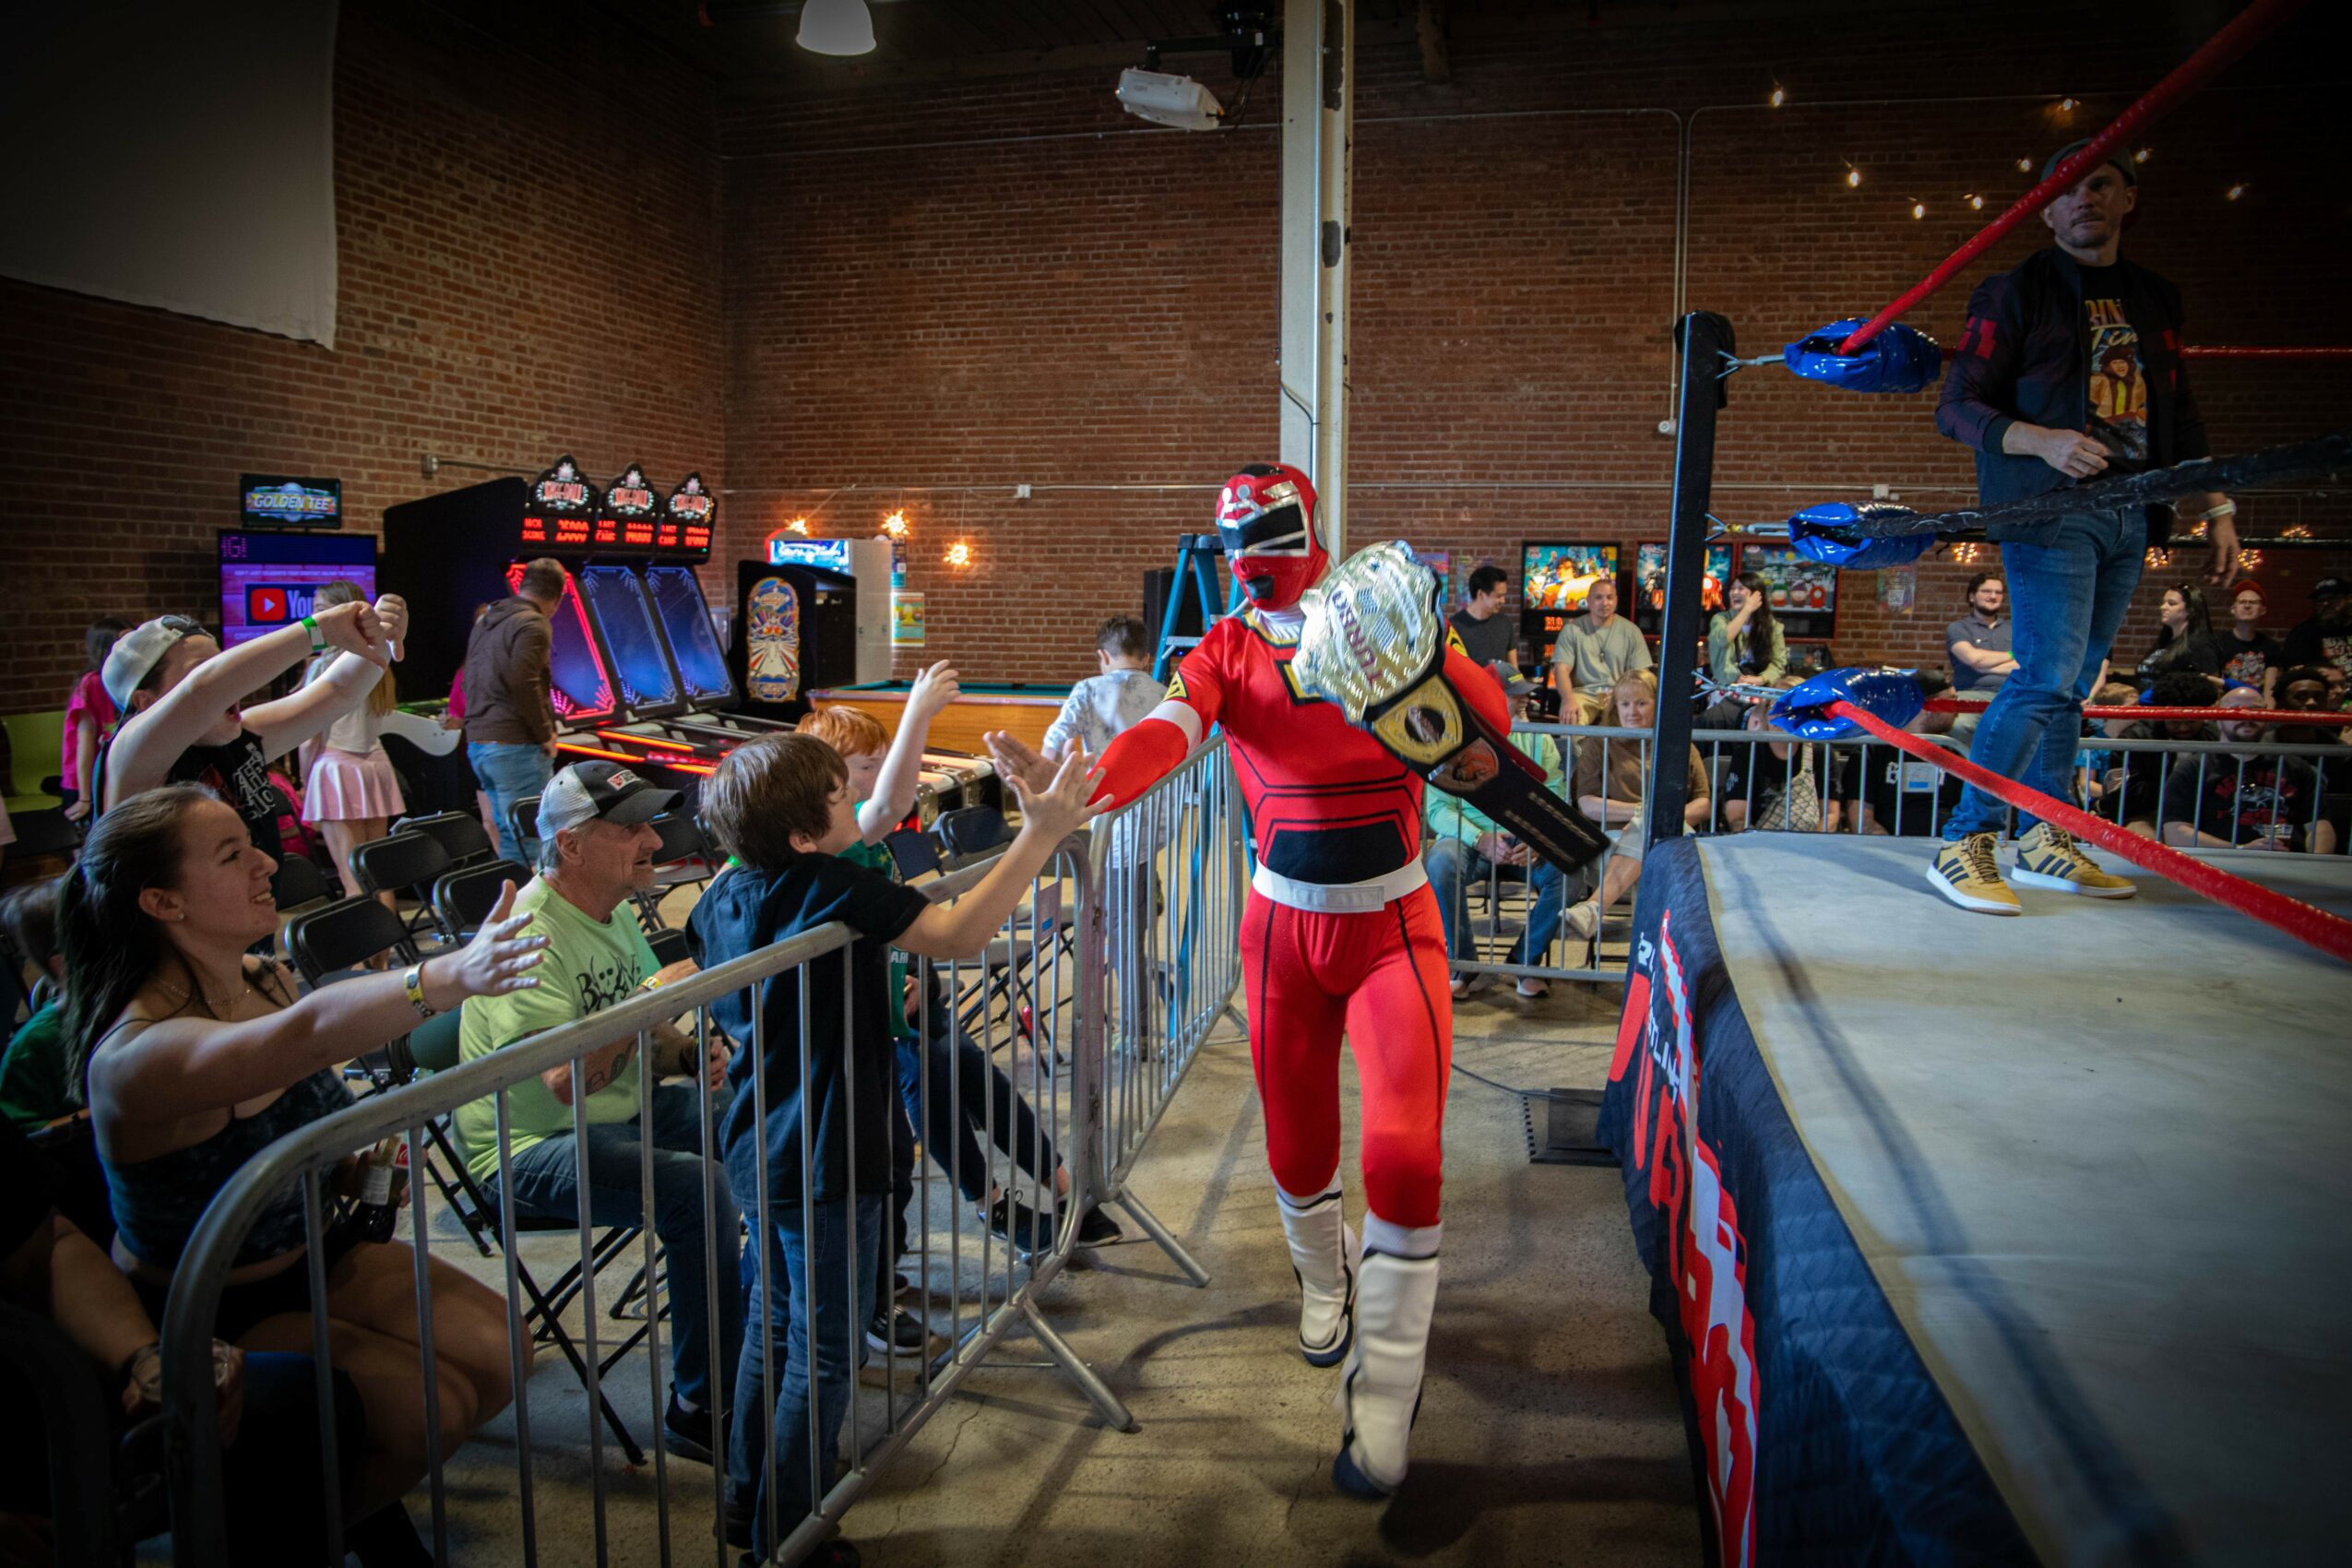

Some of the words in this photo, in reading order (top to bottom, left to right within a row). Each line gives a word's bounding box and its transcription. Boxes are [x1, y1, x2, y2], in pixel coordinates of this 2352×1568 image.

[254, 493, 303, 510] GOLDEN
[308, 497, 330, 510] TEE
[1331, 588, 1384, 686] TURBO
